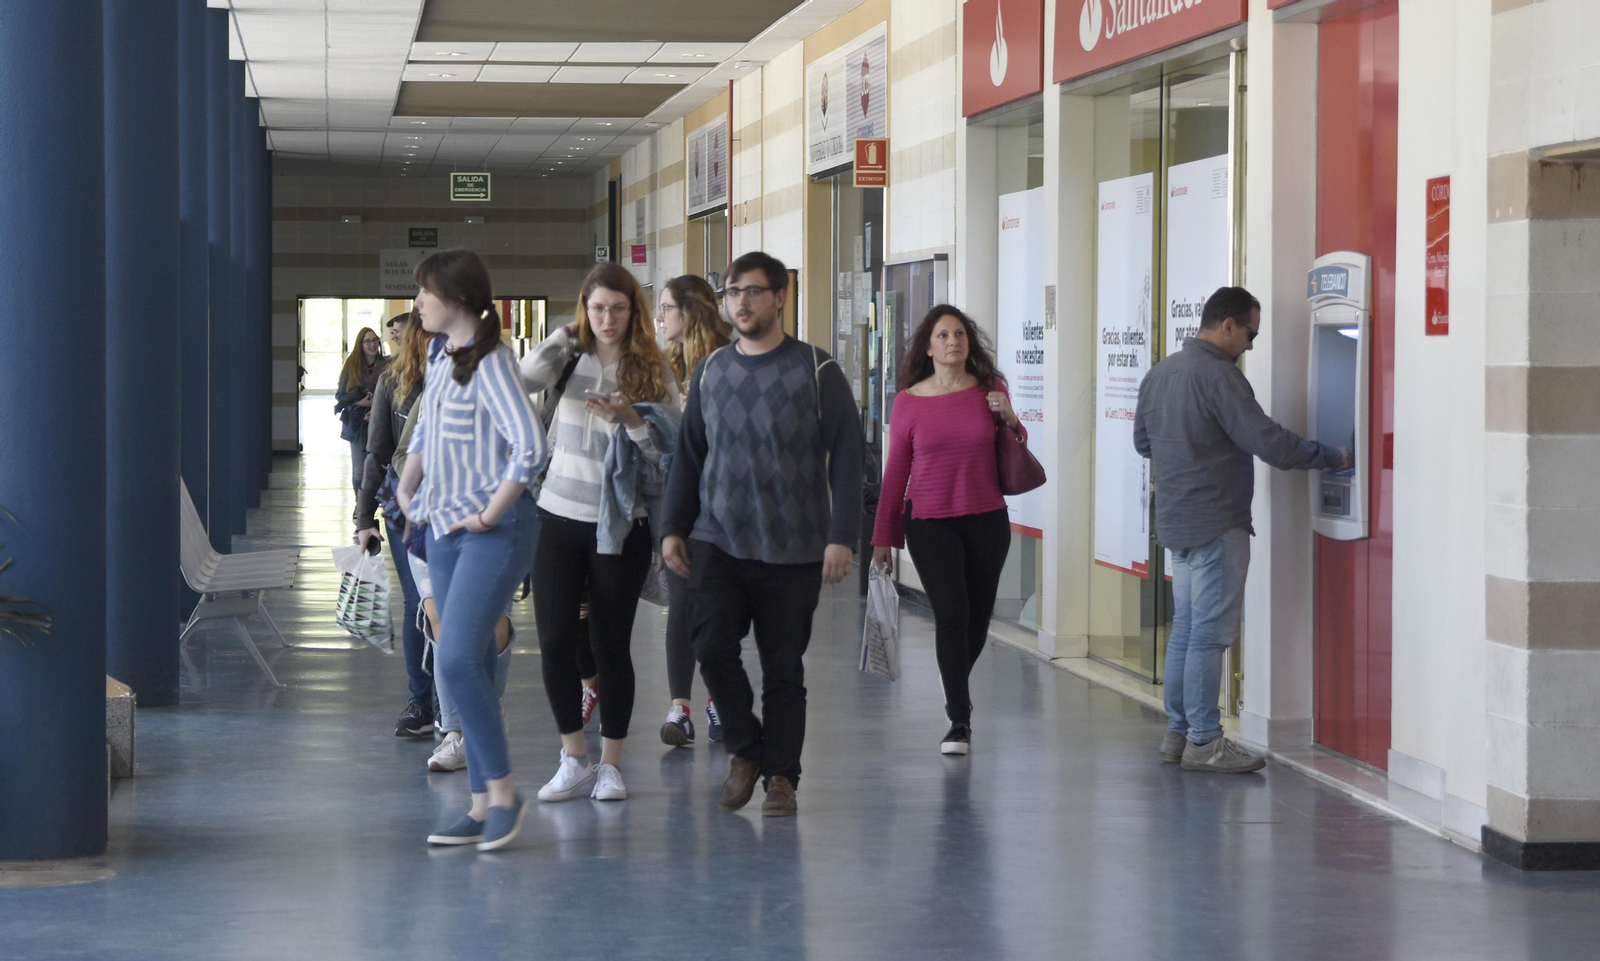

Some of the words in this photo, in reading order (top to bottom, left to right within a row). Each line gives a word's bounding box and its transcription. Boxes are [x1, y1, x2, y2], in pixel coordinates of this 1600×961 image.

[1106, 0, 1203, 39] Santan
[1320, 273, 1347, 291] TELEBANCO
[1171, 297, 1194, 321] Gracias,
[1022, 320, 1044, 341] Valientes
[1102, 327, 1121, 349] Gracias,
[1122, 326, 1146, 349] valientes,
[1175, 327, 1185, 347] por
[1016, 349, 1022, 364] os
[1022, 344, 1044, 365] necesitan
[1108, 353, 1116, 372] por
[1117, 350, 1129, 367] estar
